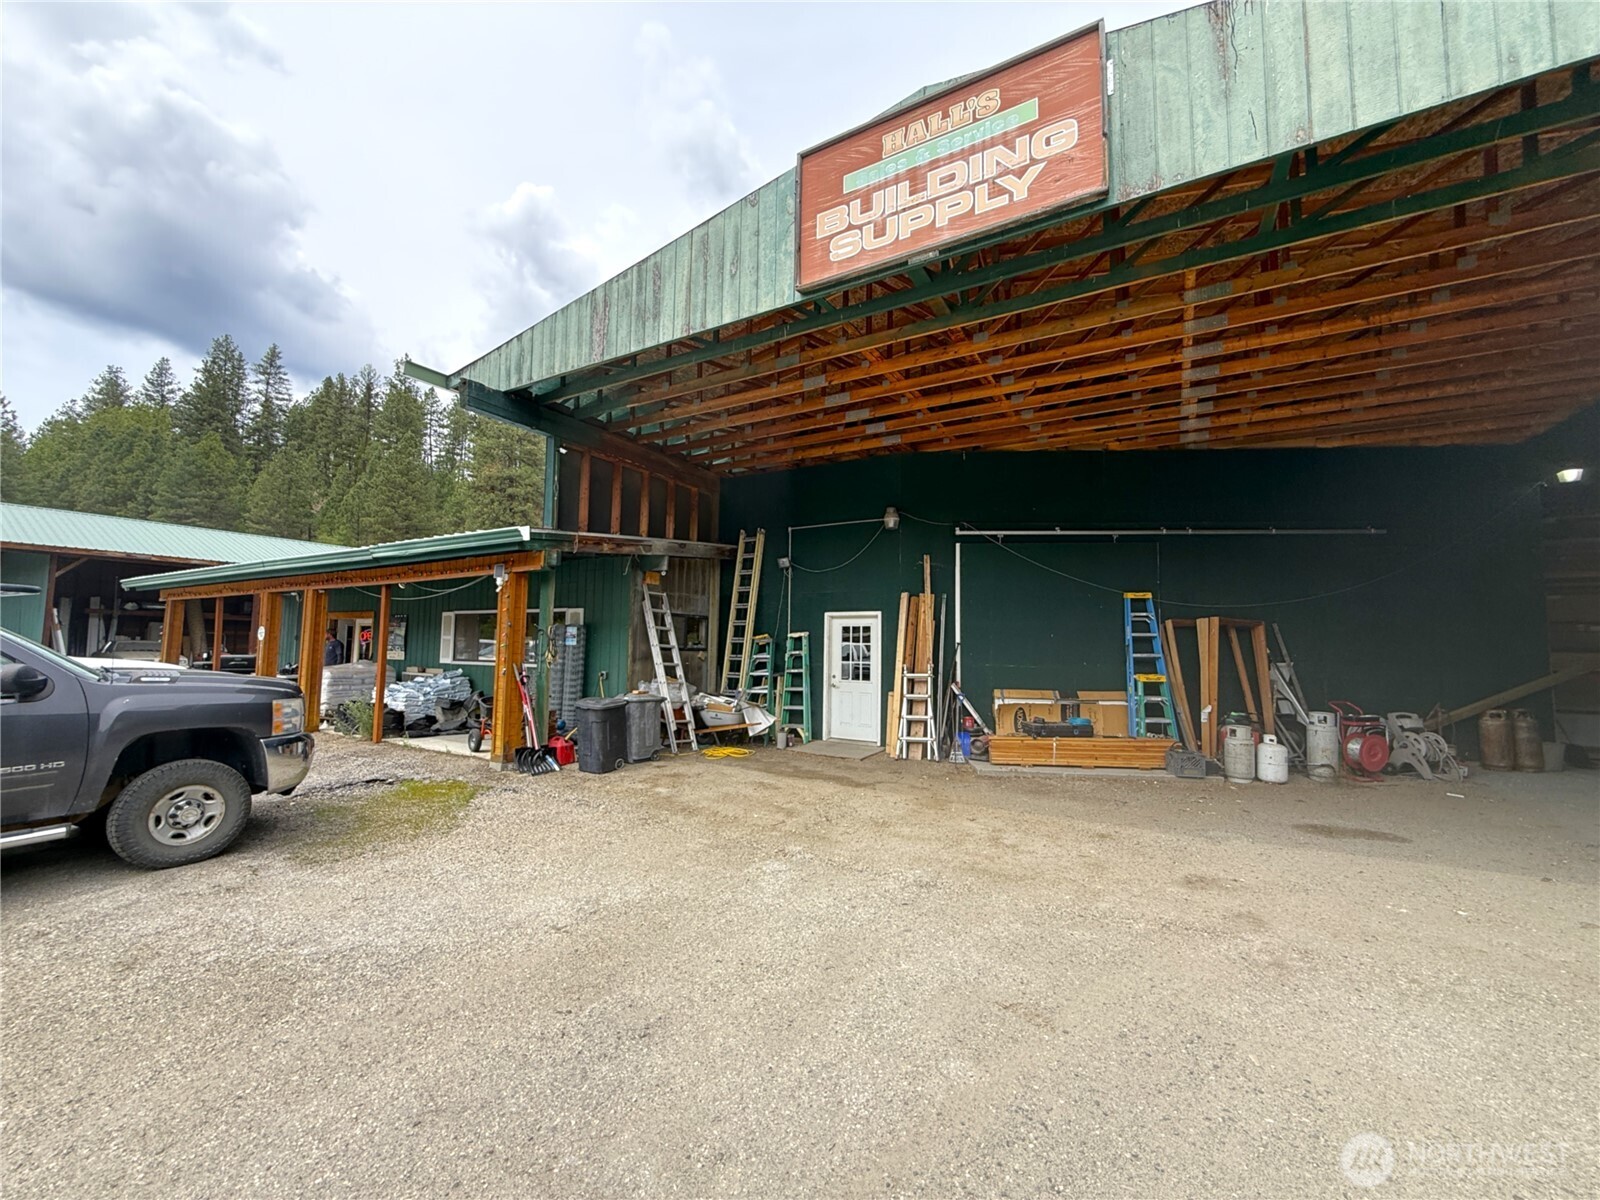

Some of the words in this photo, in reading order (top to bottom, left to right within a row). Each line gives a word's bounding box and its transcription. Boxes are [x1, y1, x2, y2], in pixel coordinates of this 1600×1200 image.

[882, 88, 1000, 159] HALL'S
[937, 114, 1019, 151] Service
[816, 118, 1078, 240] BUILDING
[829, 161, 1048, 262] SUPPLY
[40, 761, 65, 769] HD
